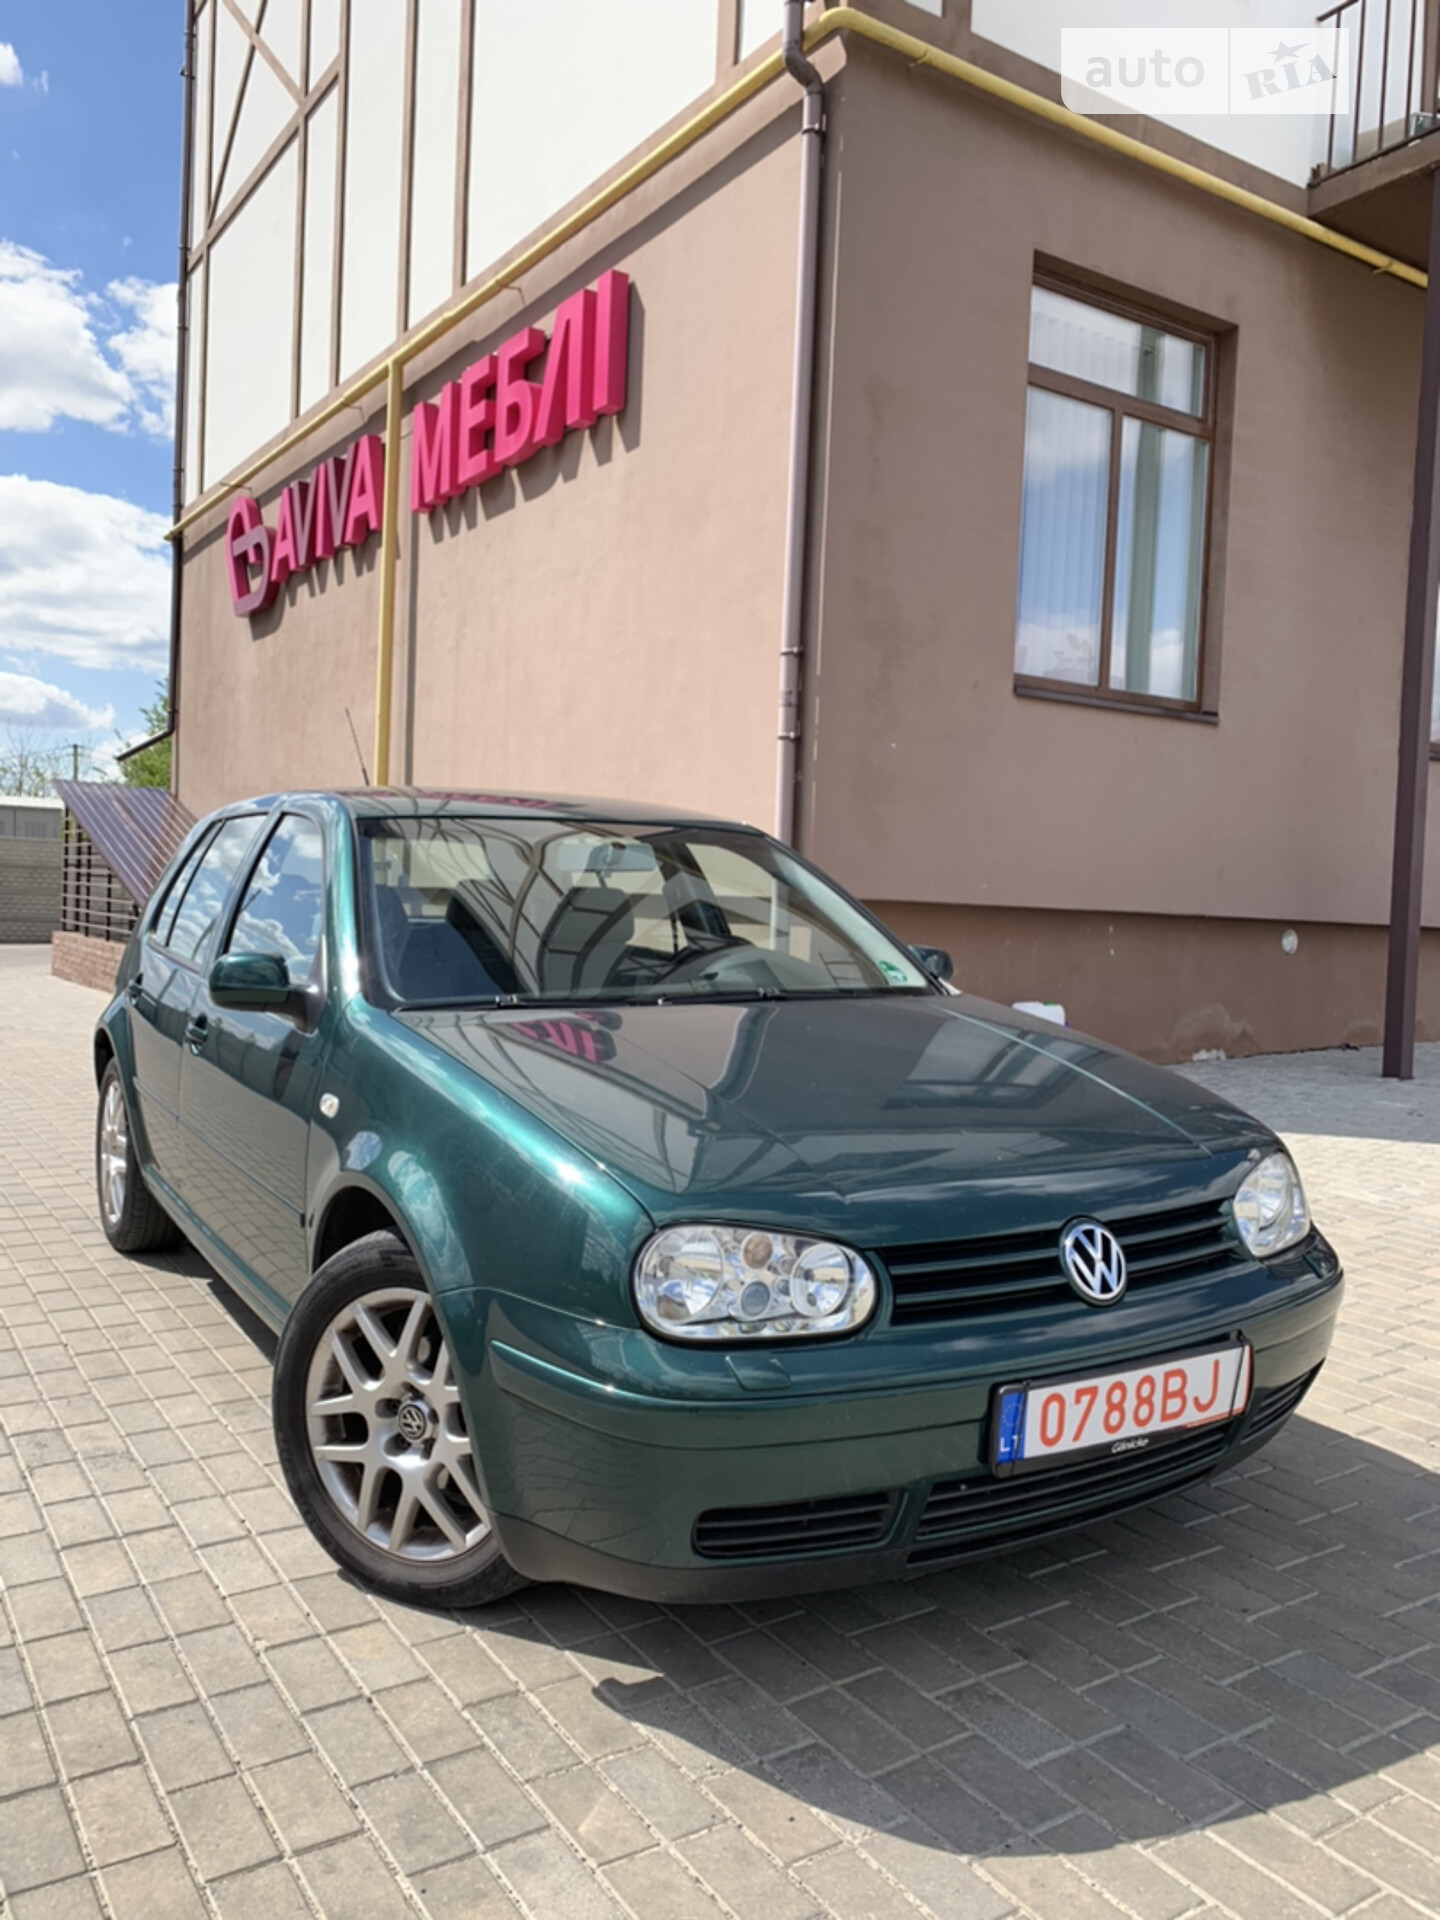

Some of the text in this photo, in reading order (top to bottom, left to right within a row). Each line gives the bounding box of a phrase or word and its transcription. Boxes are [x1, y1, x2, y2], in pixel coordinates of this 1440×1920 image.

[271, 269, 629, 584] AVIVA МЕБЛІ
[1038, 1359, 1220, 1448] 0788BJ
